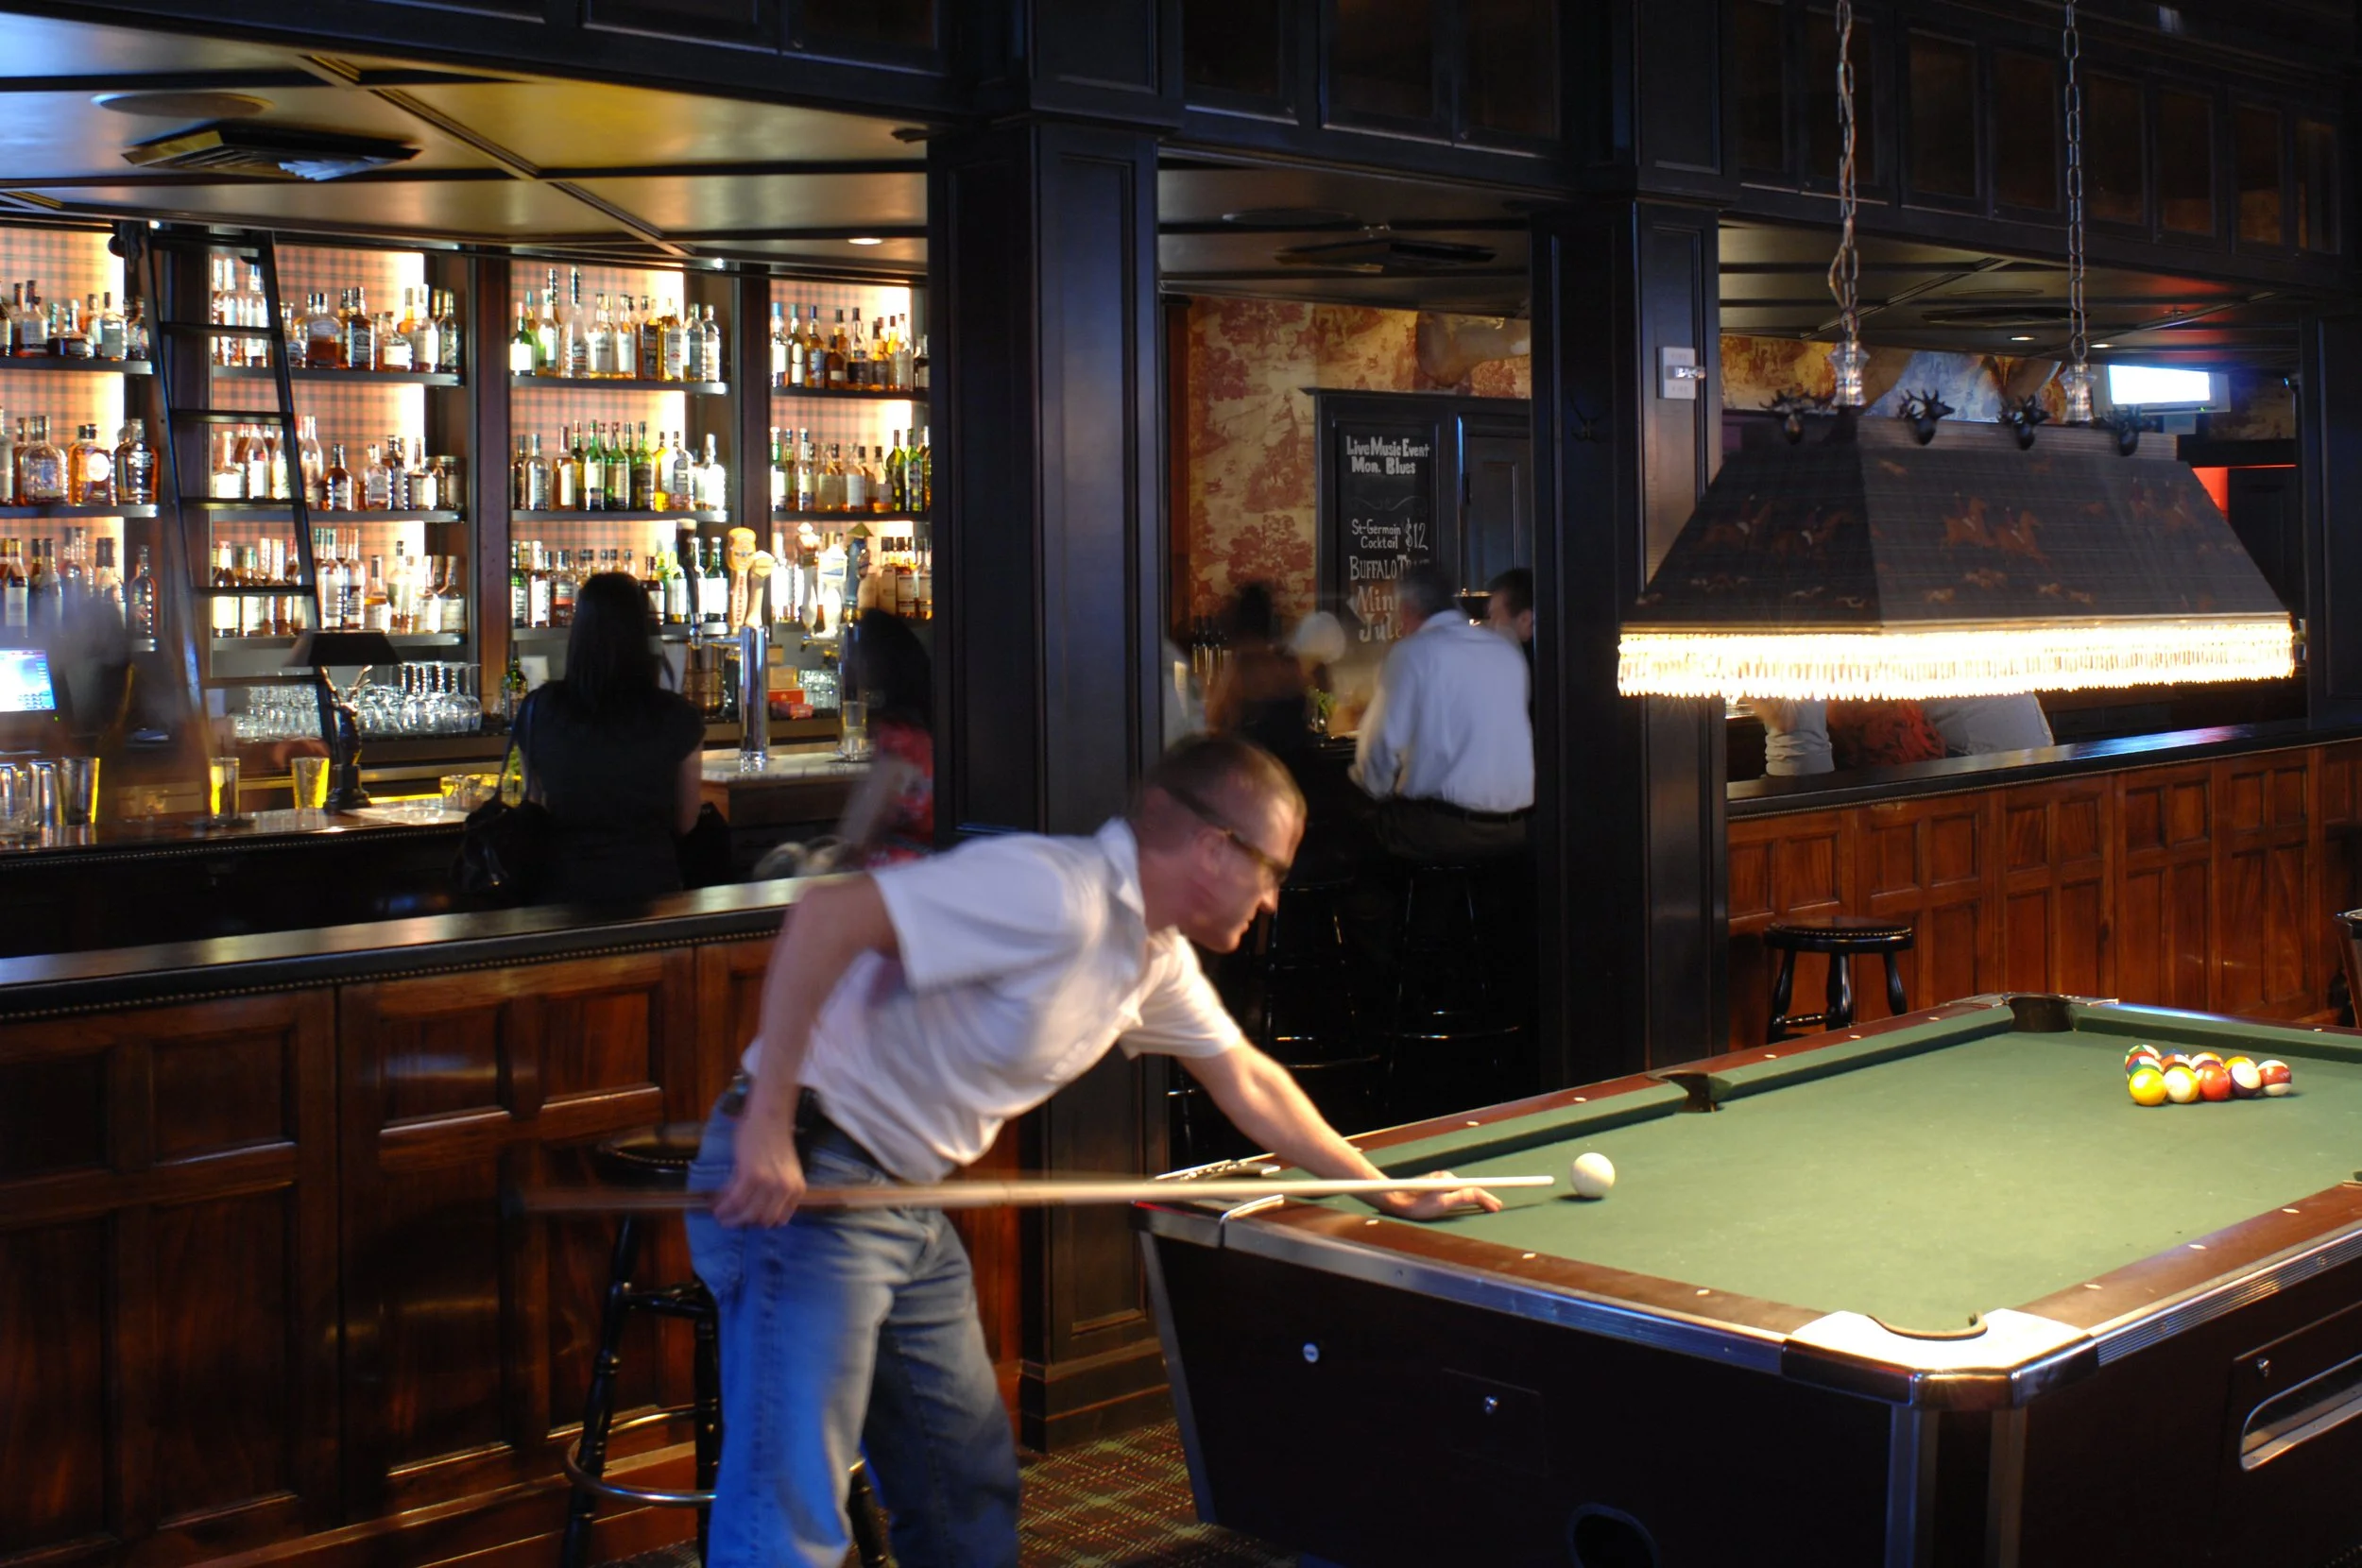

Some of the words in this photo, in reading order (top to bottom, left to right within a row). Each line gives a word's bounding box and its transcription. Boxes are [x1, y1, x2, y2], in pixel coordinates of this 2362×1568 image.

[1345, 435, 1370, 455] Live
[1370, 436, 1401, 456] Music
[1402, 437, 1429, 457] Event
[1351, 455, 1381, 473] Mon.
[1385, 457, 1416, 475] Blues
[1361, 535, 1398, 550] Cocktail
[1405, 517, 1429, 552] $12
[1349, 555, 1397, 580] BUFFALO
[1356, 585, 1400, 612] Min
[1359, 612, 1405, 642] Jule
